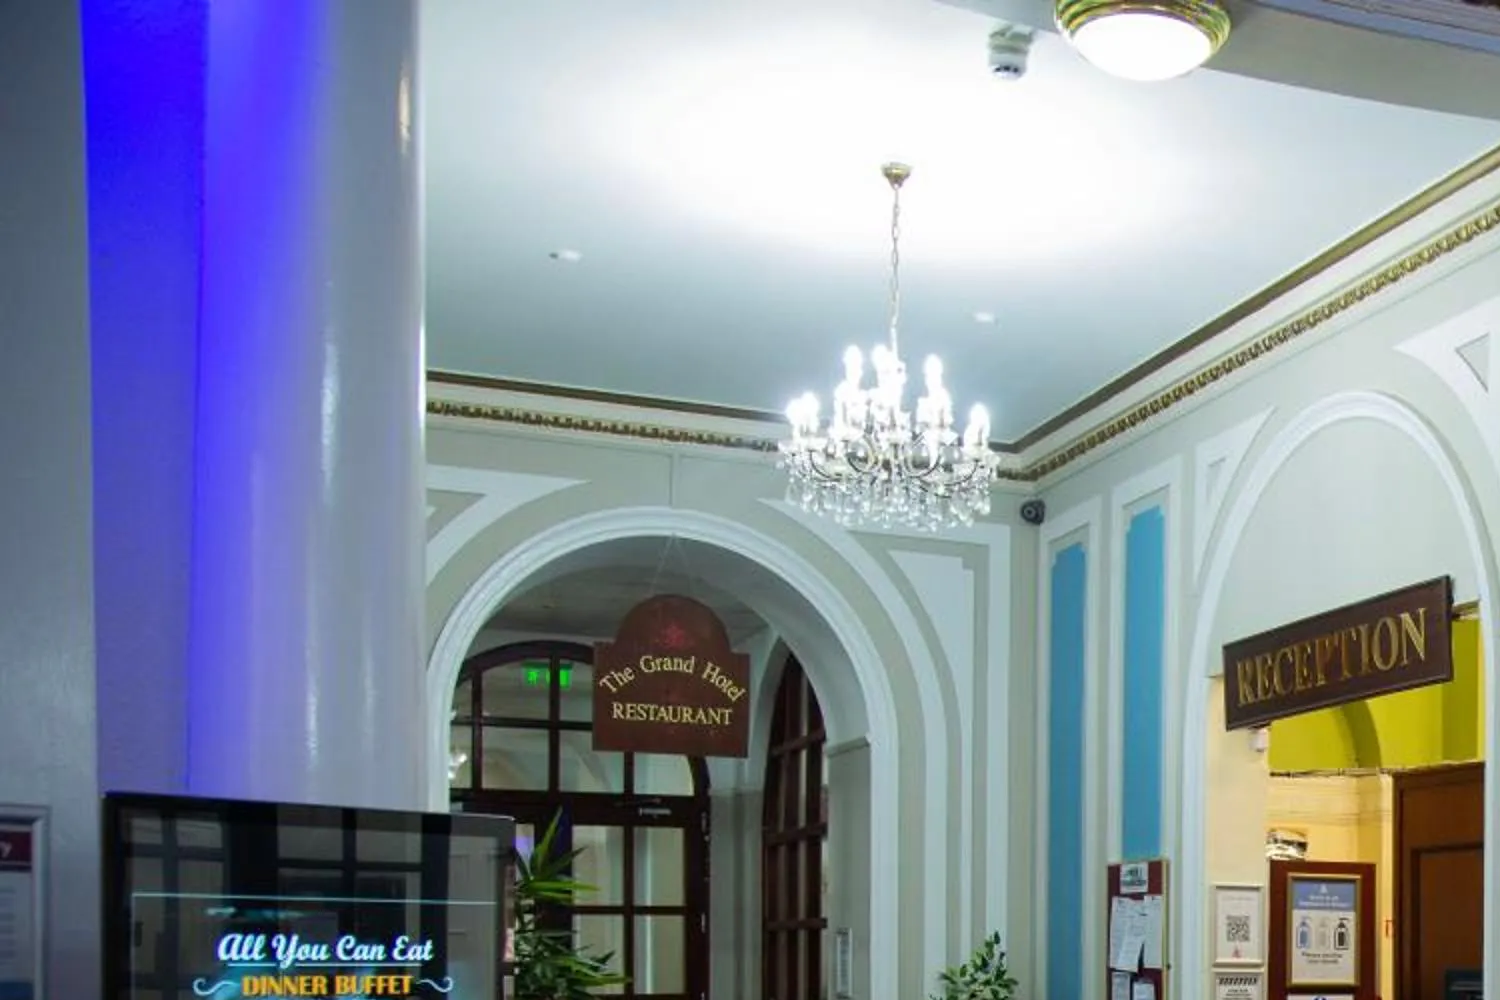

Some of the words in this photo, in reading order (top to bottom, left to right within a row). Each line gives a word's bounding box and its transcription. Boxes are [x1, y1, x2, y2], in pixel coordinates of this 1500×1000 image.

[1236, 607, 1426, 707] RECEPTION
[599, 666, 635, 693] The
[639, 655, 695, 673] Grand
[701, 661, 747, 702] Hotel
[611, 701, 733, 725] RESTAURANT
[217, 933, 267, 961] All
[271, 933, 330, 969] You
[335, 935, 385, 961] Can
[392, 935, 434, 961] Eat
[241, 975, 329, 996] DINNER
[335, 975, 413, 995] BUFFET
